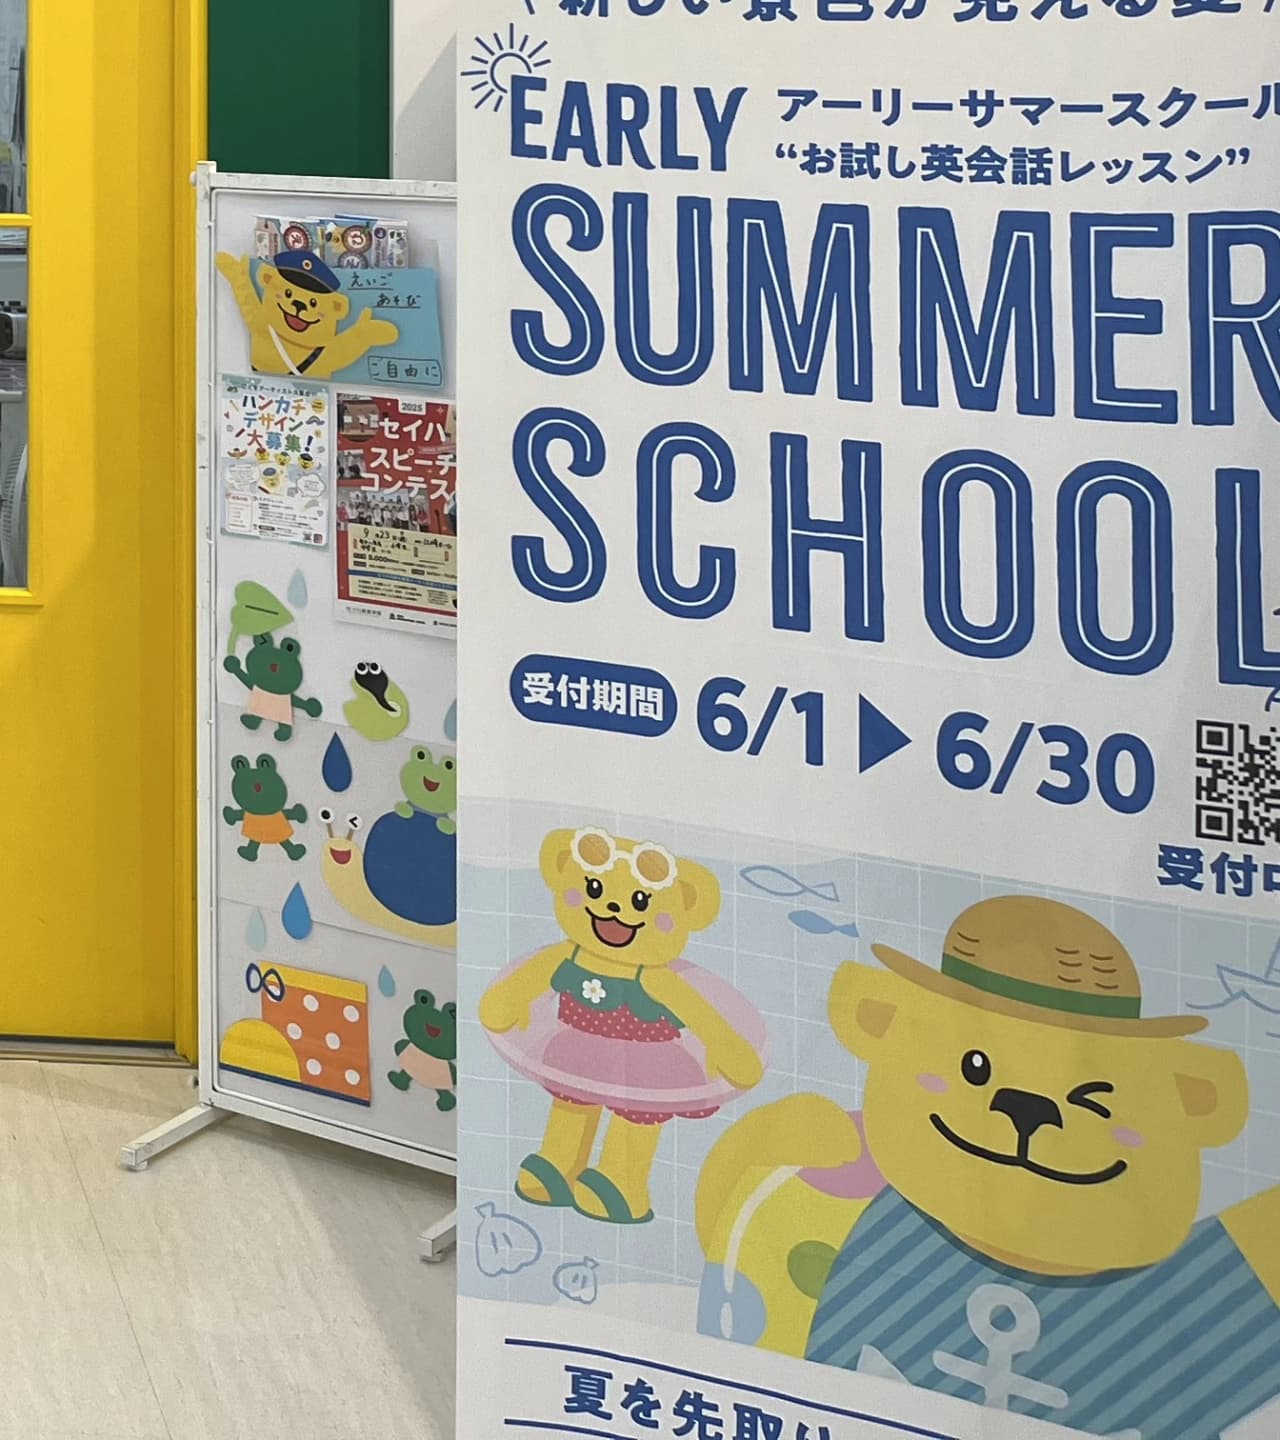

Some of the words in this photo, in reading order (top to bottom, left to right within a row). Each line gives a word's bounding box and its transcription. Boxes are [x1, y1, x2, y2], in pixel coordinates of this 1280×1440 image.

[508, 75, 748, 171] EARLY
[351, 271, 393, 287] えいご
[376, 294, 421, 307] あそび
[509, 181, 1280, 426] SUMMER
[371, 360, 439, 378] ご自由に
[242, 395, 306, 415] ハンカチ
[243, 411, 304, 432] デザイン
[379, 418, 448, 442] セイハ
[370, 446, 456, 476] スピーチ
[361, 472, 456, 502] コンテス
[510, 406, 1280, 687] SCHOOL
[521, 672, 666, 723] 受付期間
[695, 675, 825, 766] 6/1
[935, 710, 1156, 815] 6/30
